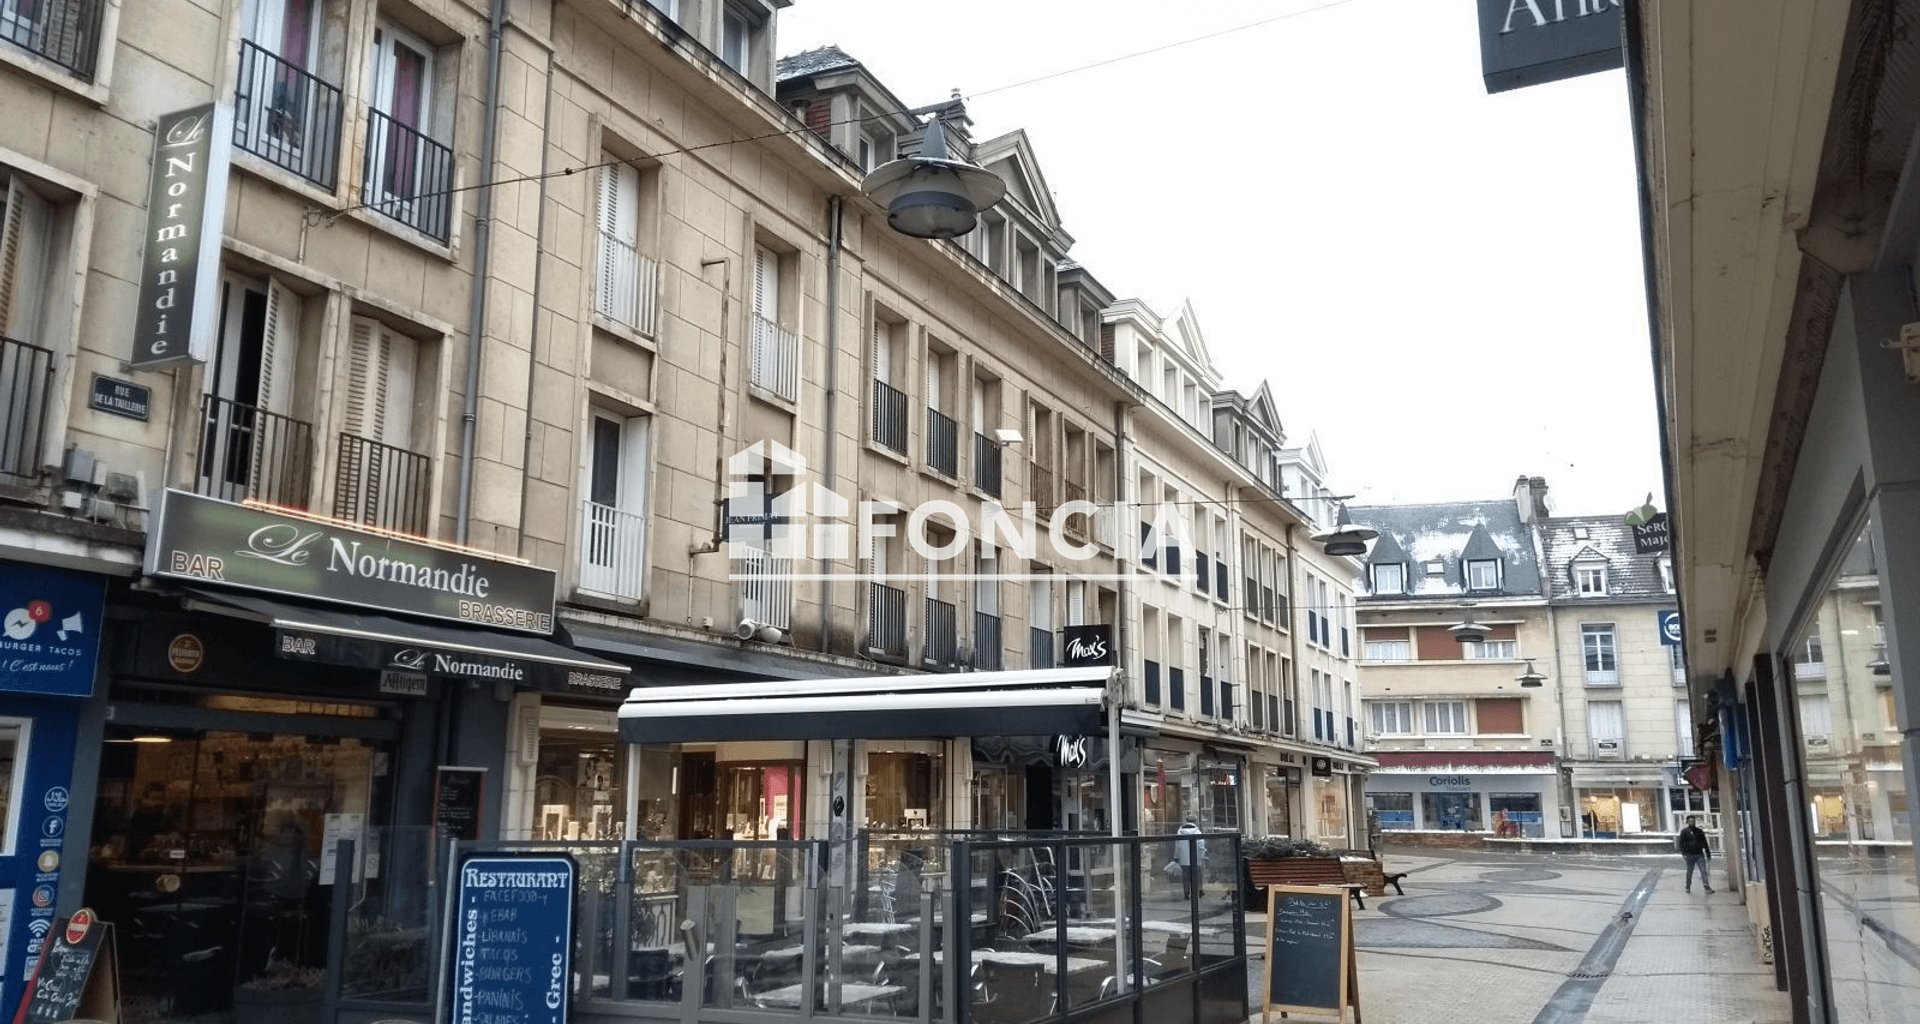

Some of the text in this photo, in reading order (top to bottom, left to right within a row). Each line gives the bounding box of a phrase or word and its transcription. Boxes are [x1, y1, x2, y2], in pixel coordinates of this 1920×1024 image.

[158, 112, 212, 149] Le
[151, 152, 196, 355] Normandie
[94, 393, 147, 414] DE LA TAILLERIE
[115, 385, 129, 397] RUE
[171, 550, 225, 581] BAR
[234, 523, 489, 598] Le Normandie
[458, 600, 551, 631] BRASSERIE
[49, 646, 82, 656] TACOS
[282, 635, 315, 655] BAR
[1066, 635, 1107, 660] Max's
[39, 663, 65, 671] nous
[387, 649, 524, 681] Le Normandie
[568, 672, 622, 690] BRASSERIE
[1056, 734, 1086, 769] Max's
[1429, 776, 1471, 787] Coriolis
[465, 868, 568, 888] RESTAURANT
[546, 953, 562, 1009] Grec
